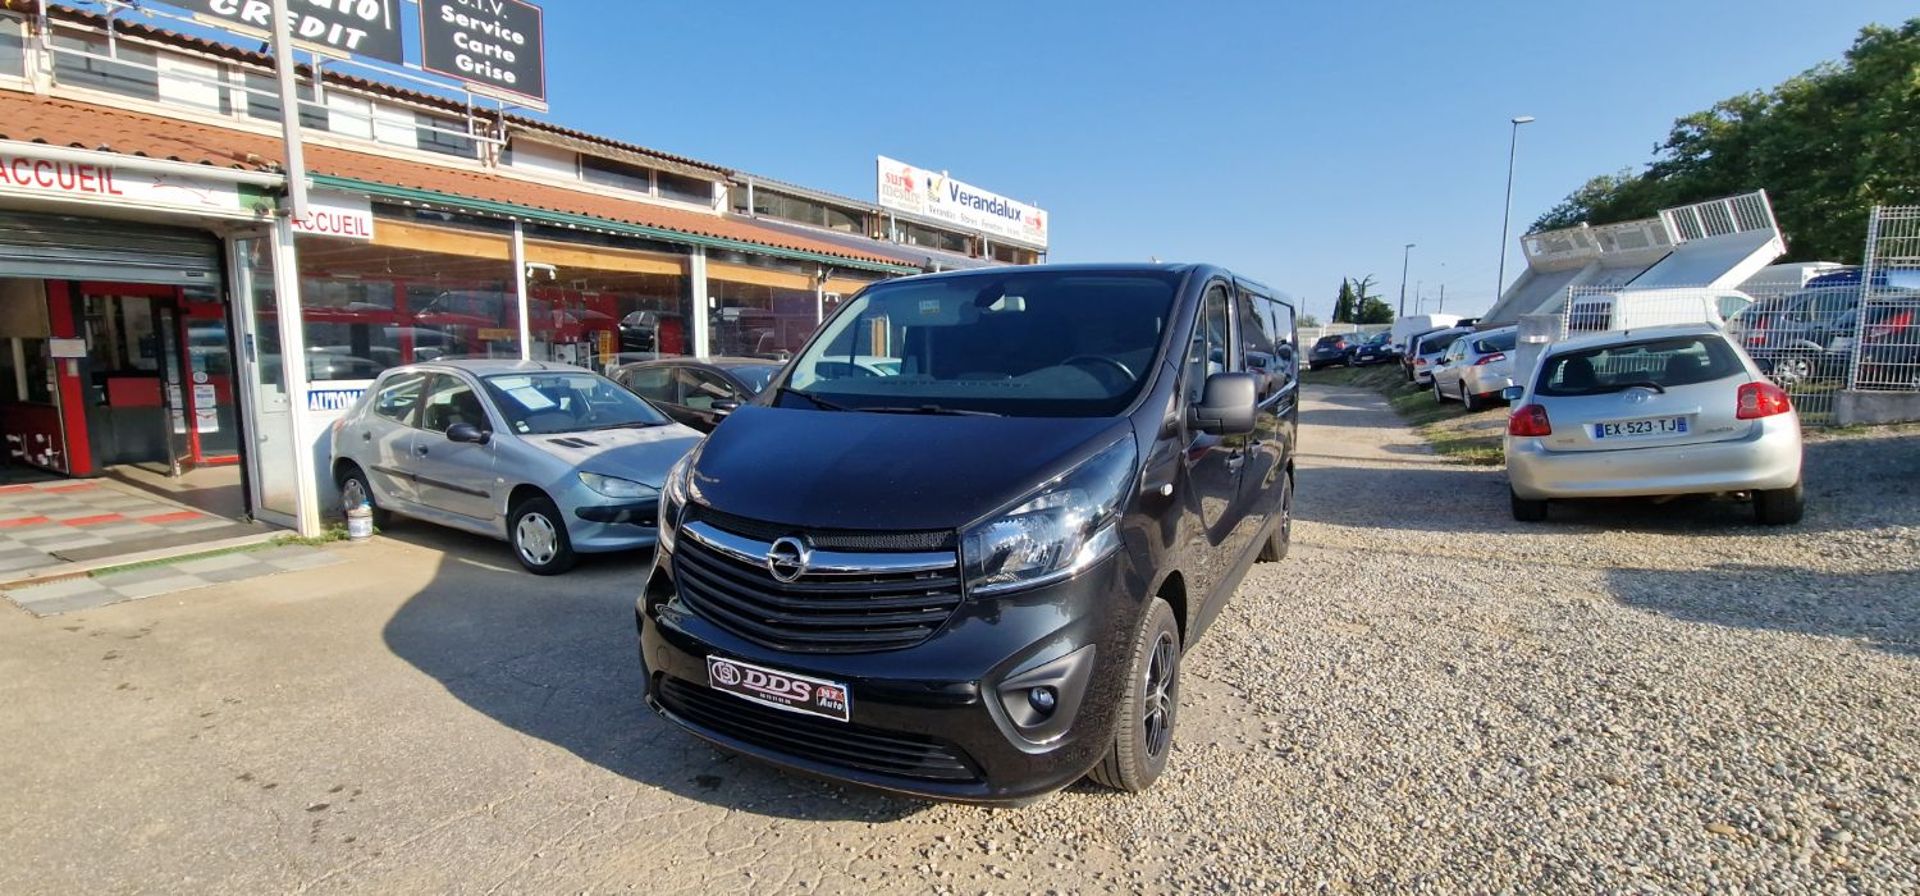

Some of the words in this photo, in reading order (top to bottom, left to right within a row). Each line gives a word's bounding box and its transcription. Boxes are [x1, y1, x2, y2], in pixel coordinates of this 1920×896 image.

[441, 5, 524, 45] Service
[453, 32, 516, 62] Carte
[455, 54, 516, 84] Grise
[949, 181, 1021, 222] Verandalux
[743, 669, 812, 702] DDS
